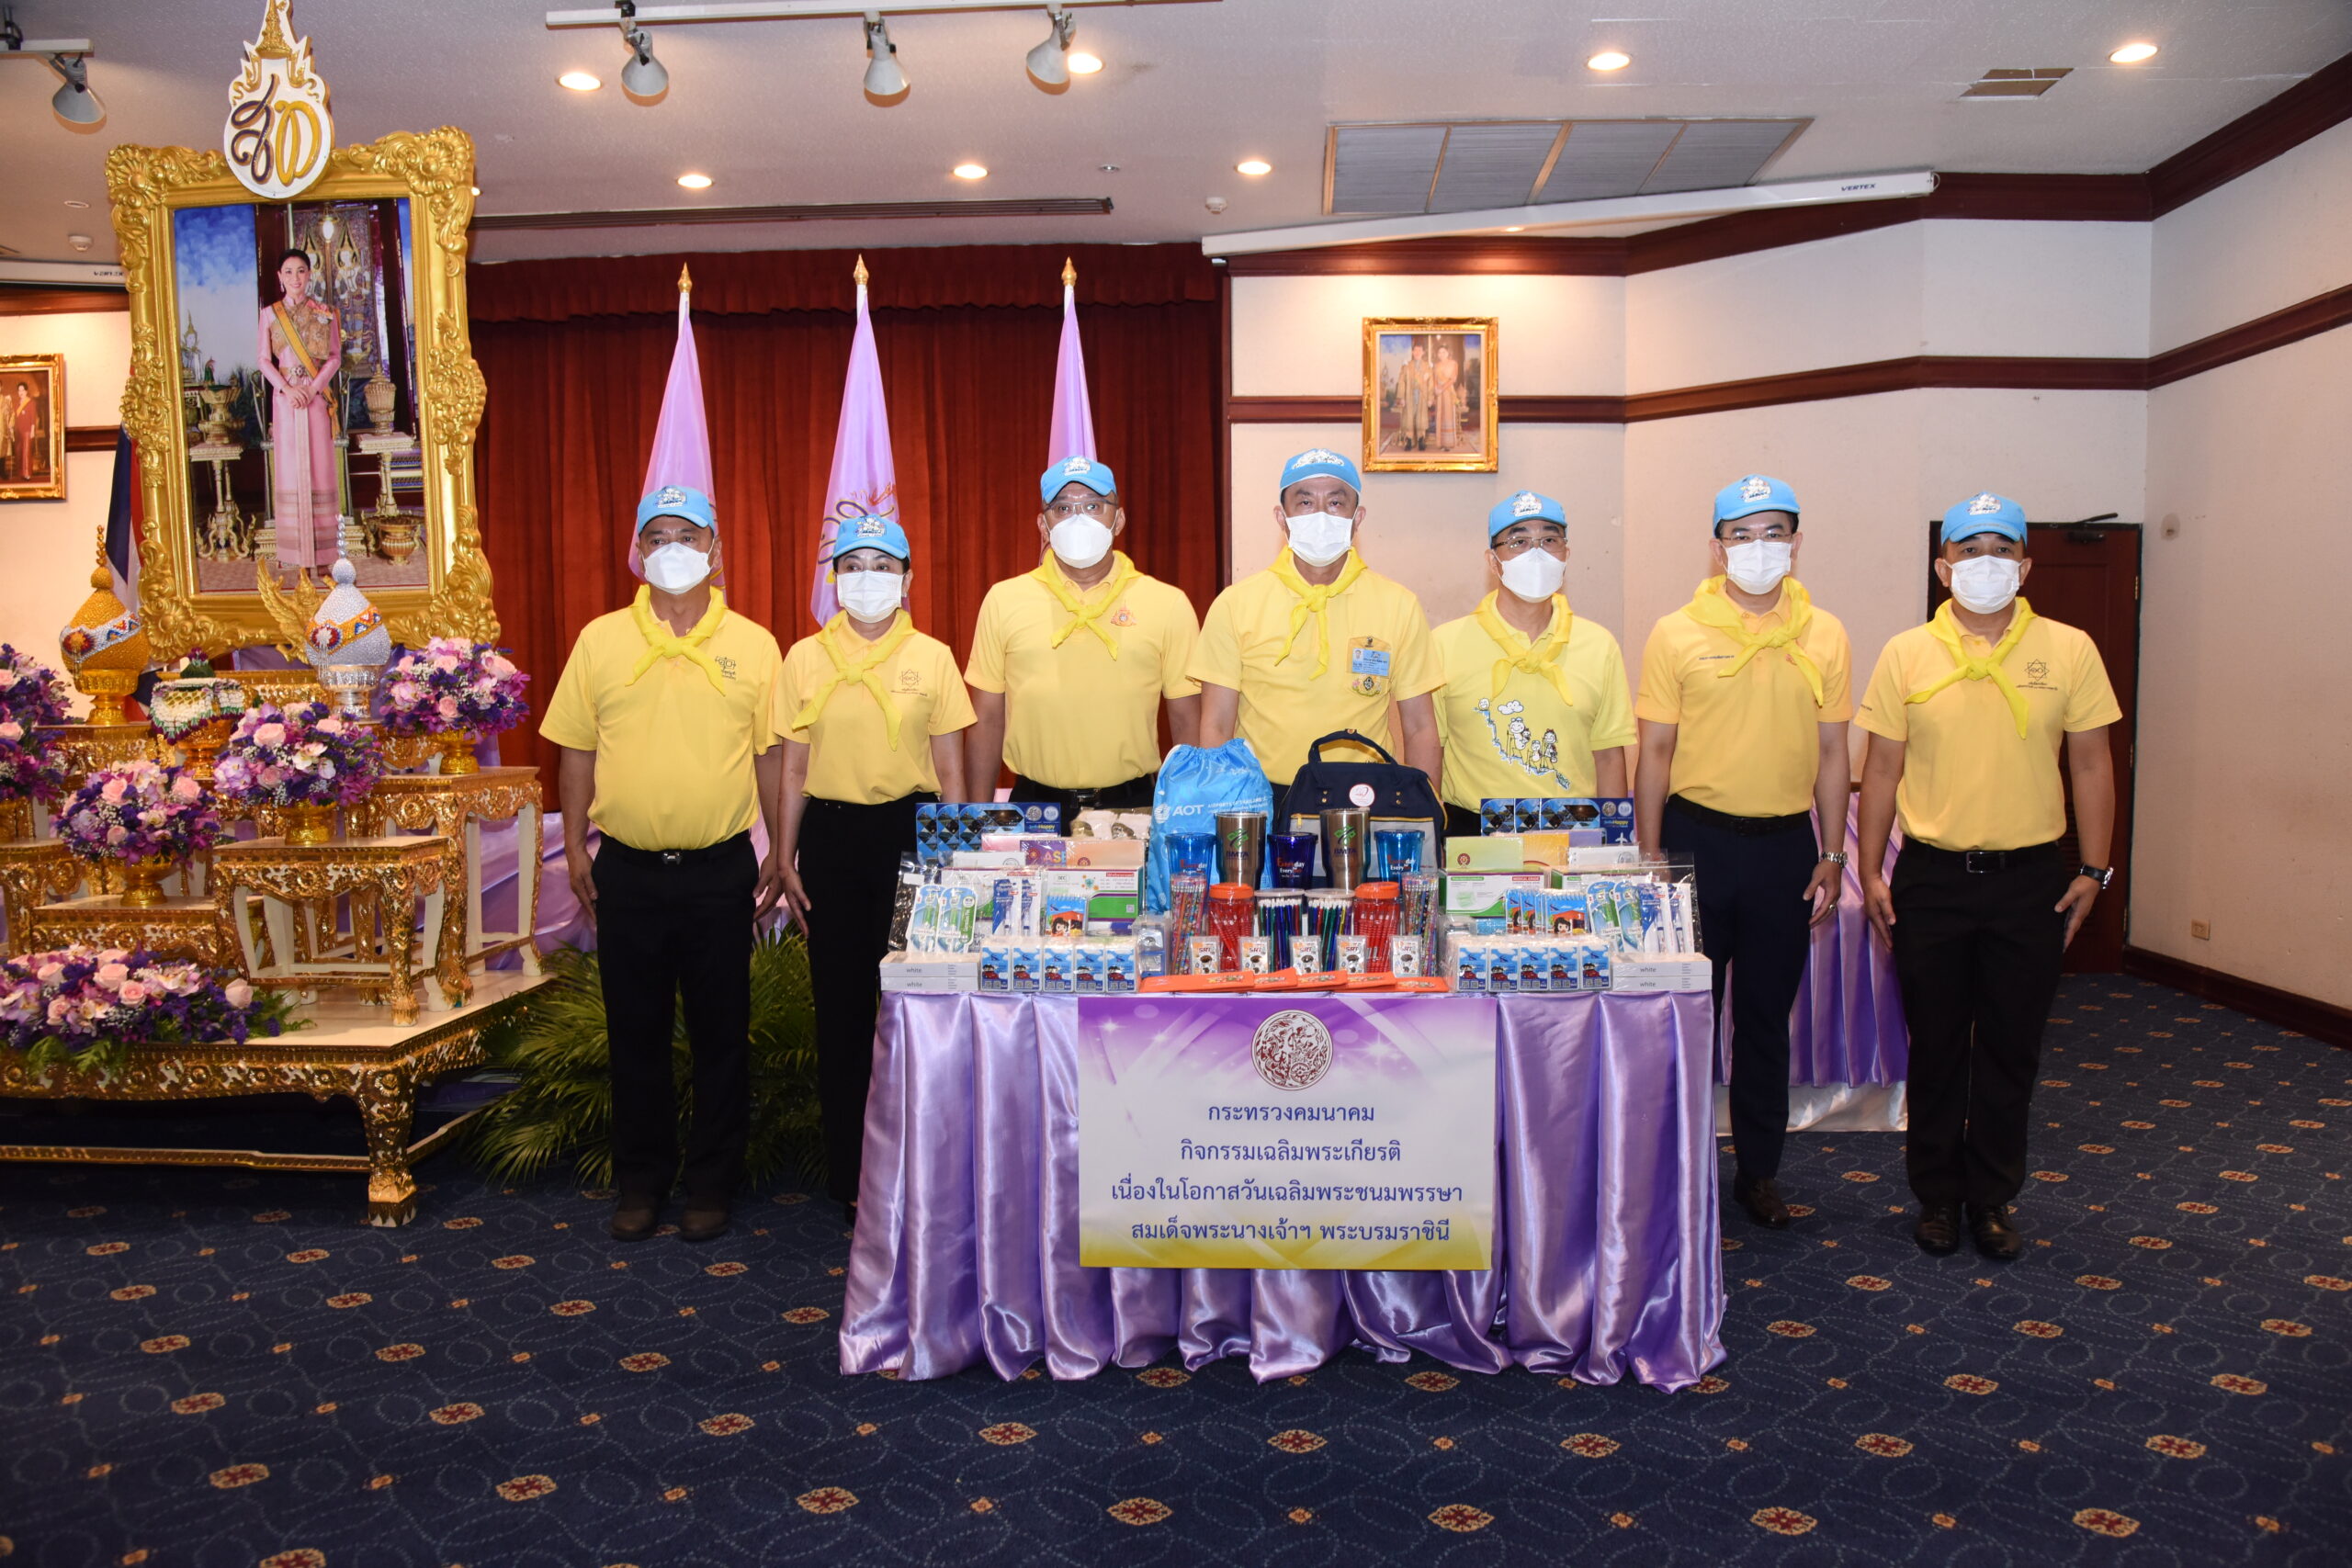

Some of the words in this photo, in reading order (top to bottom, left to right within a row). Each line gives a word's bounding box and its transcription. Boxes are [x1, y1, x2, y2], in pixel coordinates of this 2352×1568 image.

[1841, 184, 1876, 192] VERTEX
[1171, 804, 1204, 817] AOT
[1208, 1105, 1375, 1122] กระทรวงคมนาคม
[1181, 1138, 1402, 1162] กิจกรรมเฉลิมพระเกียรติ
[1112, 1173, 1464, 1202] เนื่องในโอกาสวันเฉลิมพระชนมพรรษา
[1131, 1216, 1311, 1240] สมเด็จพระนางเจ้าฯ
[1320, 1218, 1451, 1242] พระบรมราชินี
